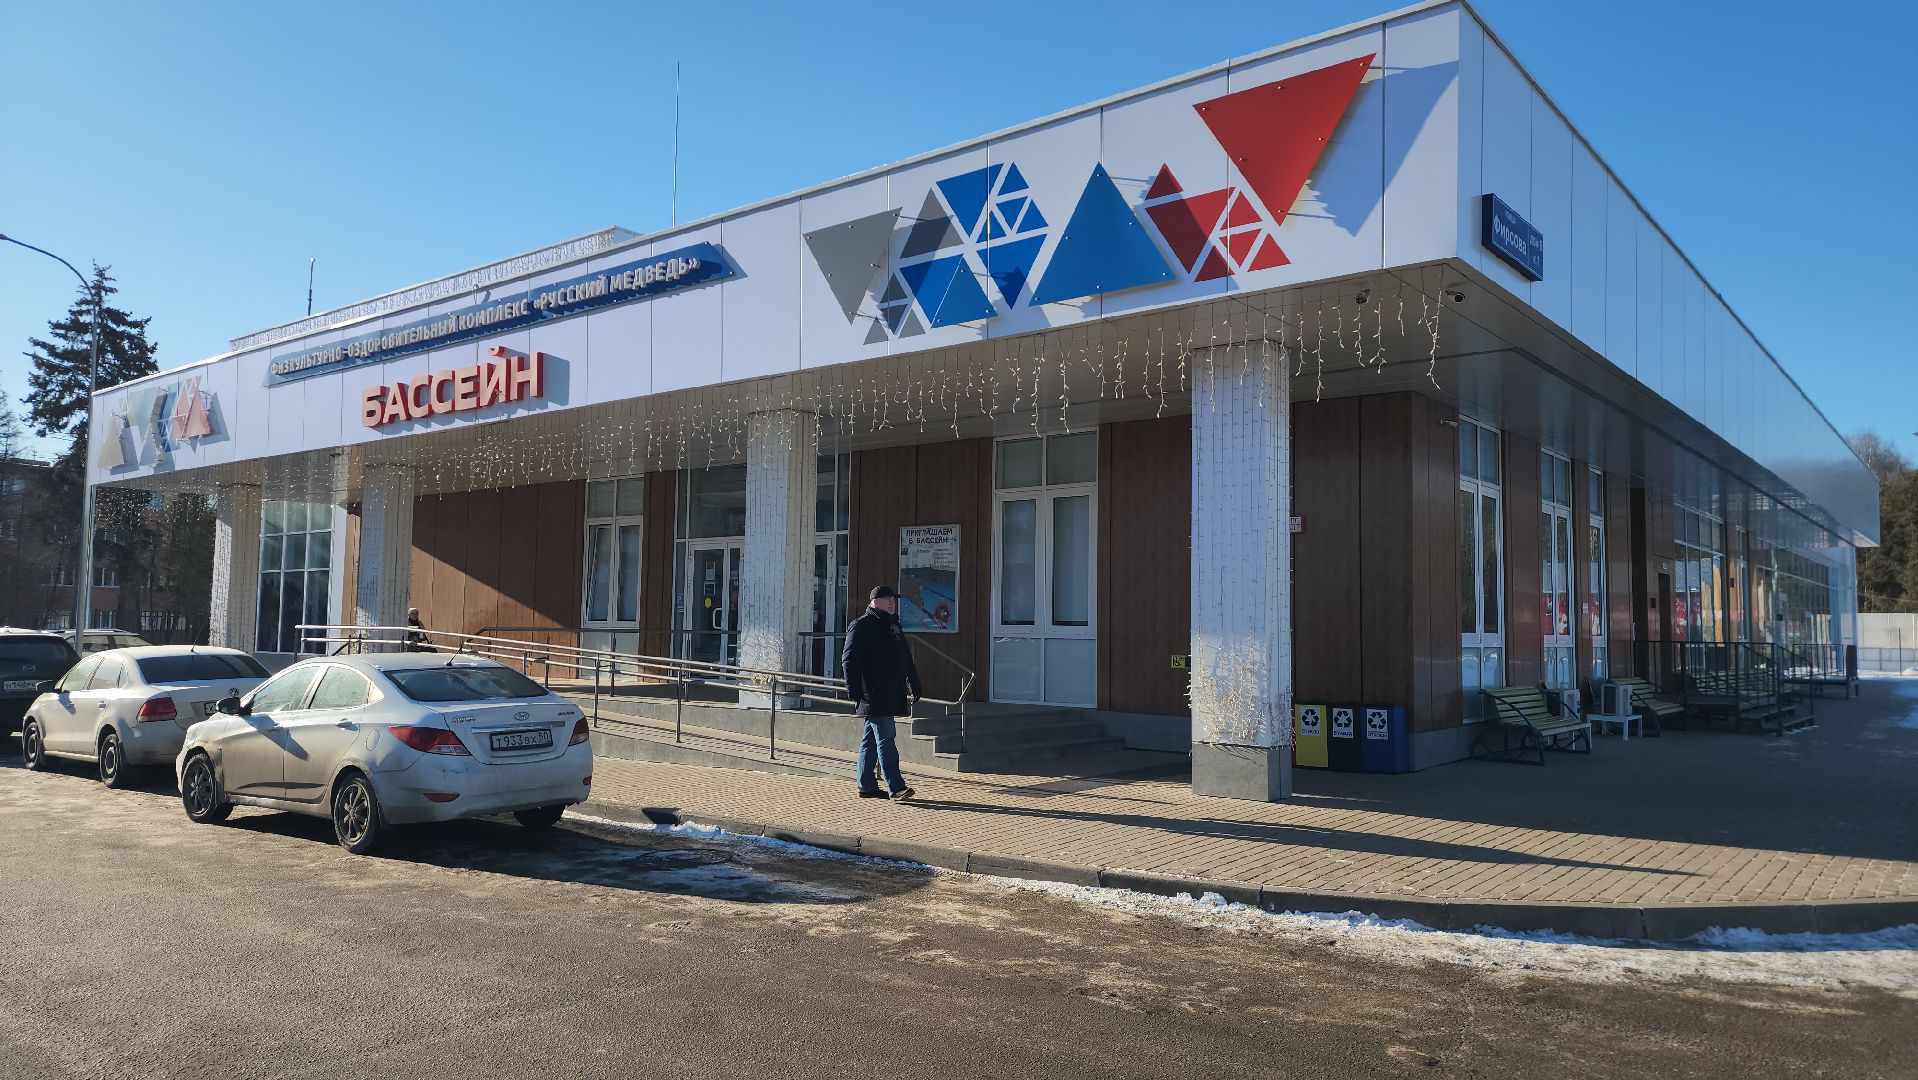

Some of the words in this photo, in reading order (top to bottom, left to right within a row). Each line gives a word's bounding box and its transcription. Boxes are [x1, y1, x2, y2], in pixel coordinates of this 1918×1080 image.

[1493, 214, 1527, 255] Фирсова
[458, 298, 531, 332] КОМПЛЕКС
[533, 274, 609, 311] «РУССКИЙ
[609, 257, 701, 293] МЕДВЕДЬ»
[361, 345, 544, 427] БАССЕЙН
[538, 732, 548, 740] 50
